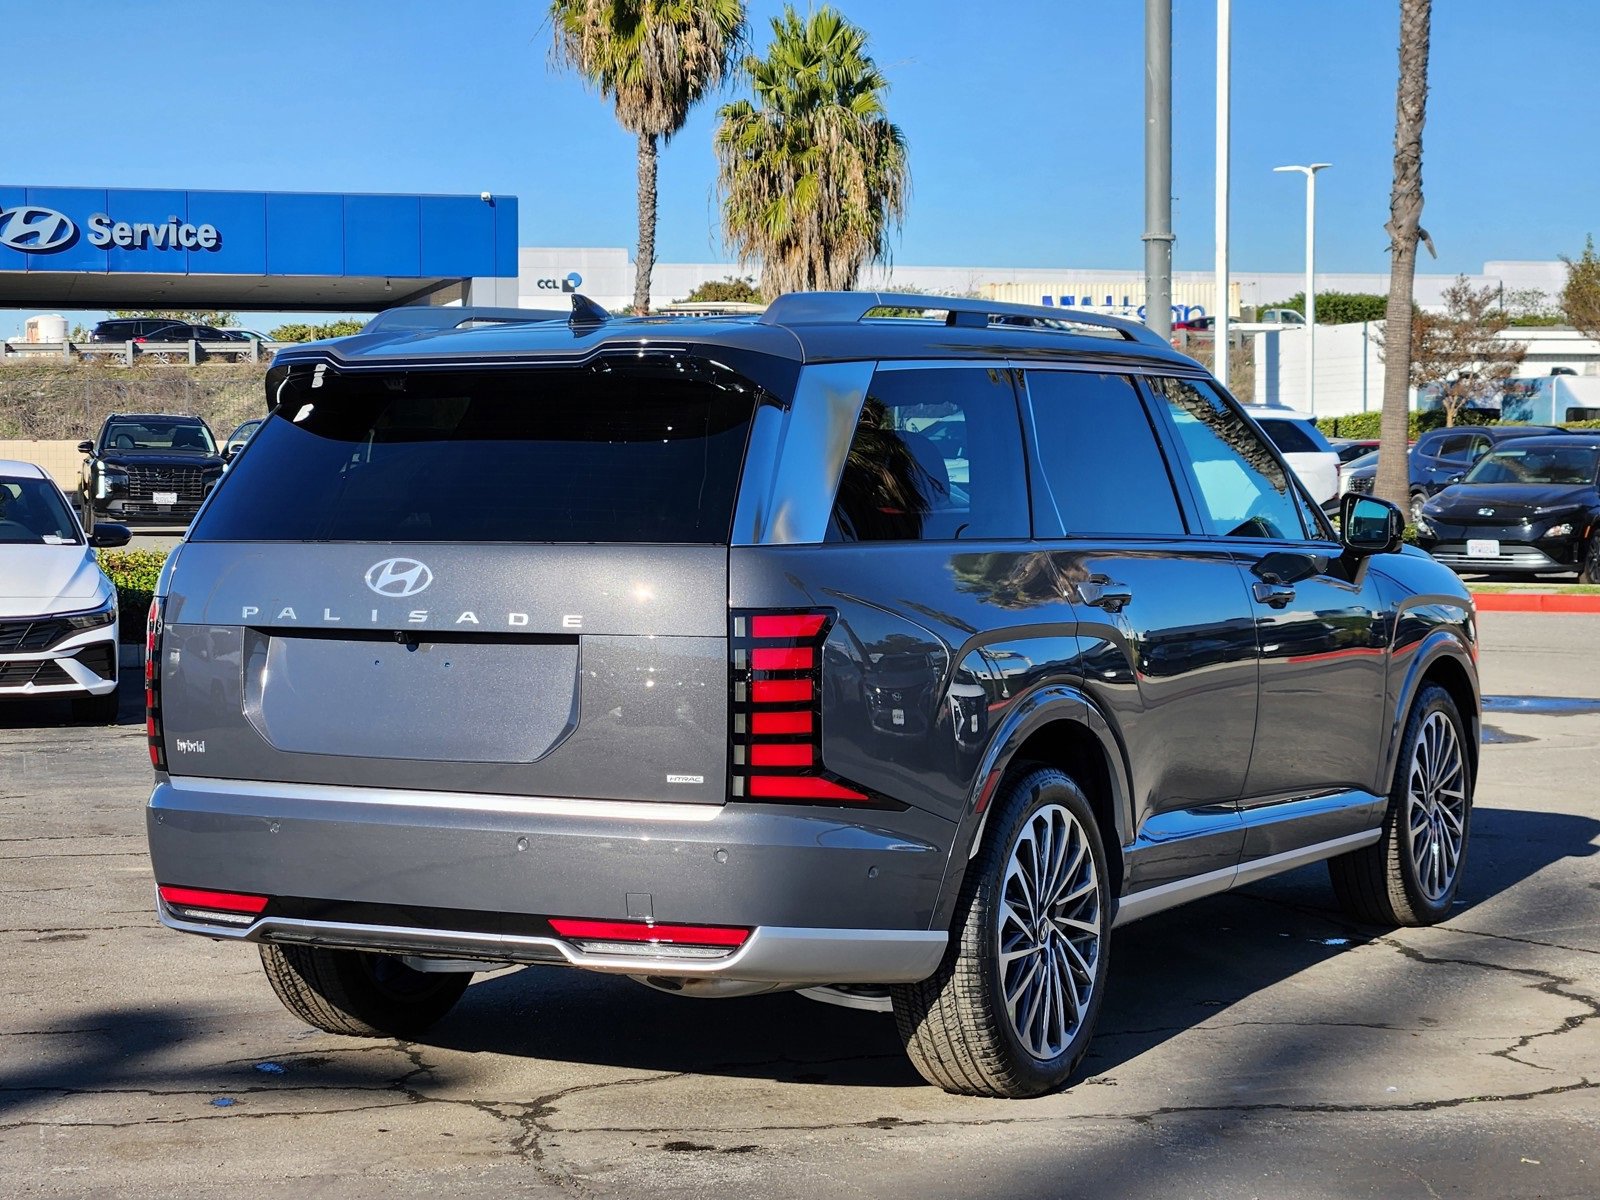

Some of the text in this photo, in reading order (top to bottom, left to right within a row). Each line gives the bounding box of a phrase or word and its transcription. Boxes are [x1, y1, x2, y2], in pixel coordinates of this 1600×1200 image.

[87, 211, 218, 248] Service
[537, 279, 560, 290] CCL
[241, 606, 583, 628] PALISADE
[176, 739, 206, 754] hybrid
